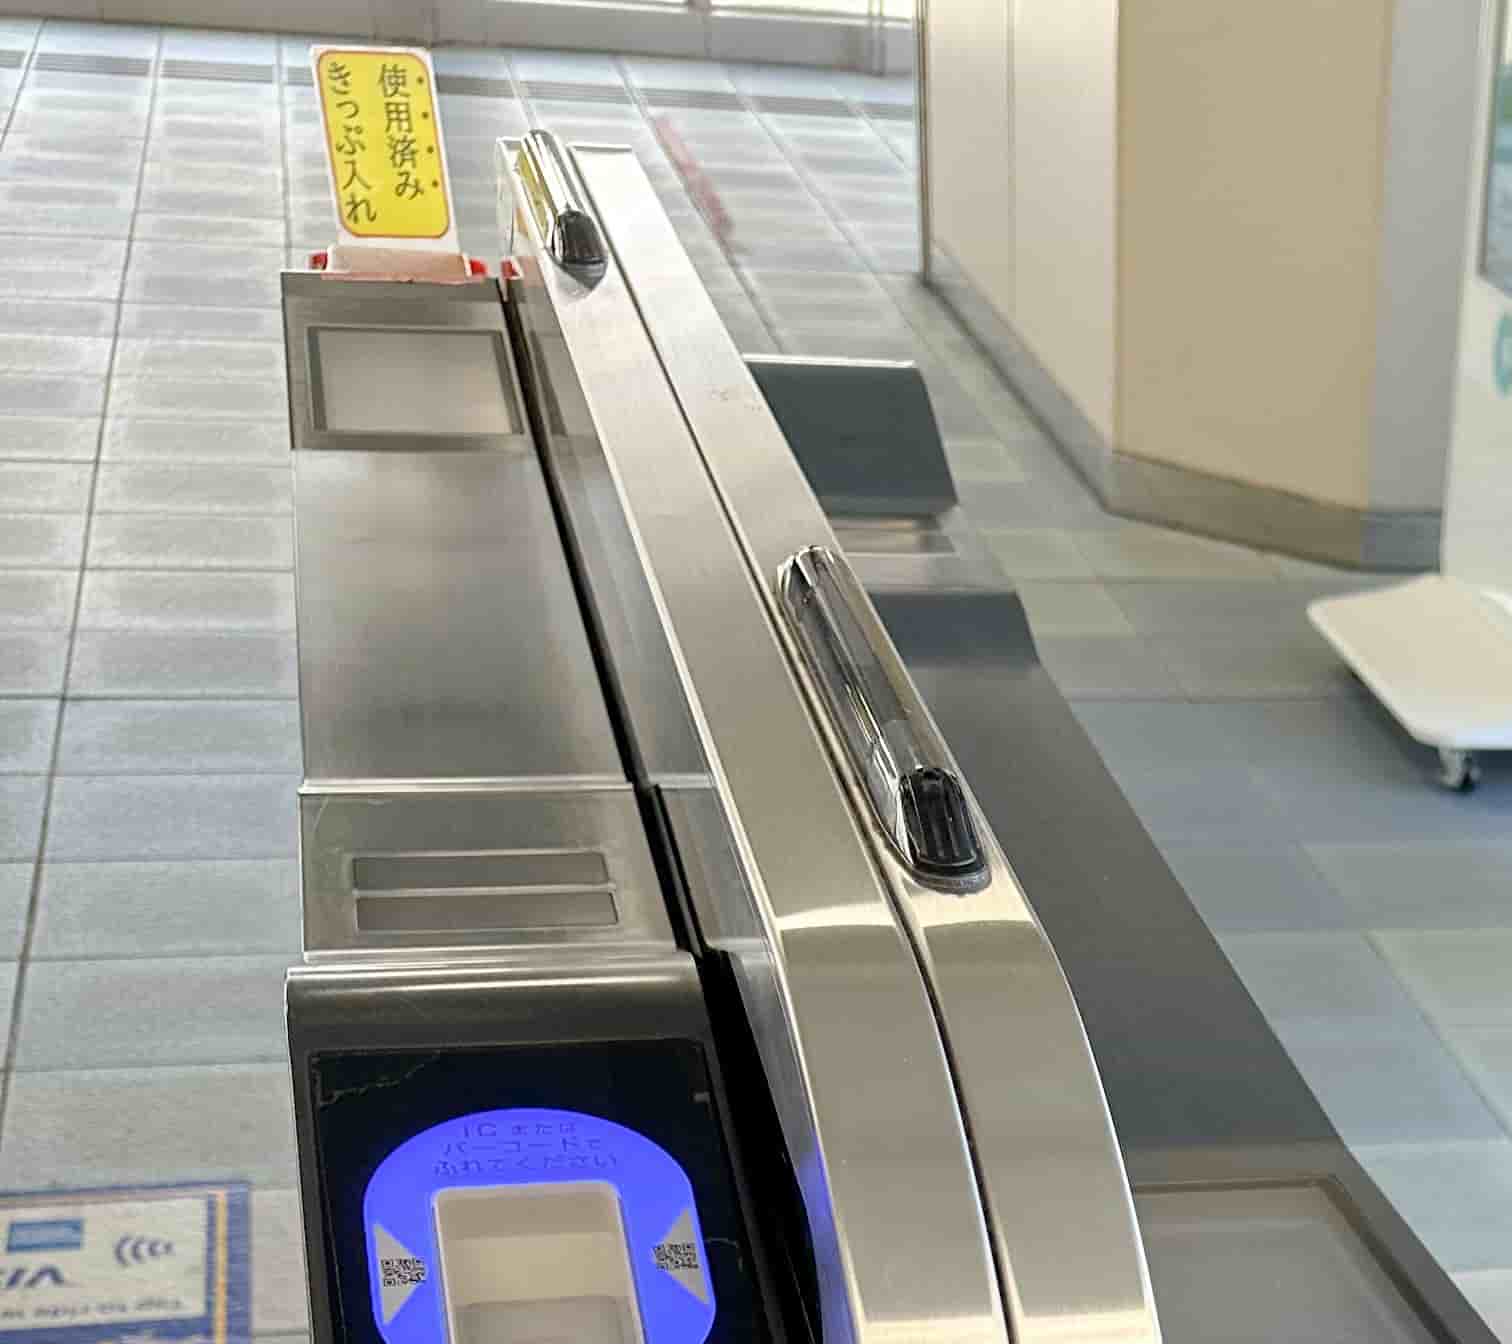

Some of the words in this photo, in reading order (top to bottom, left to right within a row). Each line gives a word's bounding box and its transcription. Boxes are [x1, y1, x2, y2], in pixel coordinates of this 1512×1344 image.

[325, 61, 377, 225] きっぷ入れ
[378, 62, 426, 200] 使用済み
